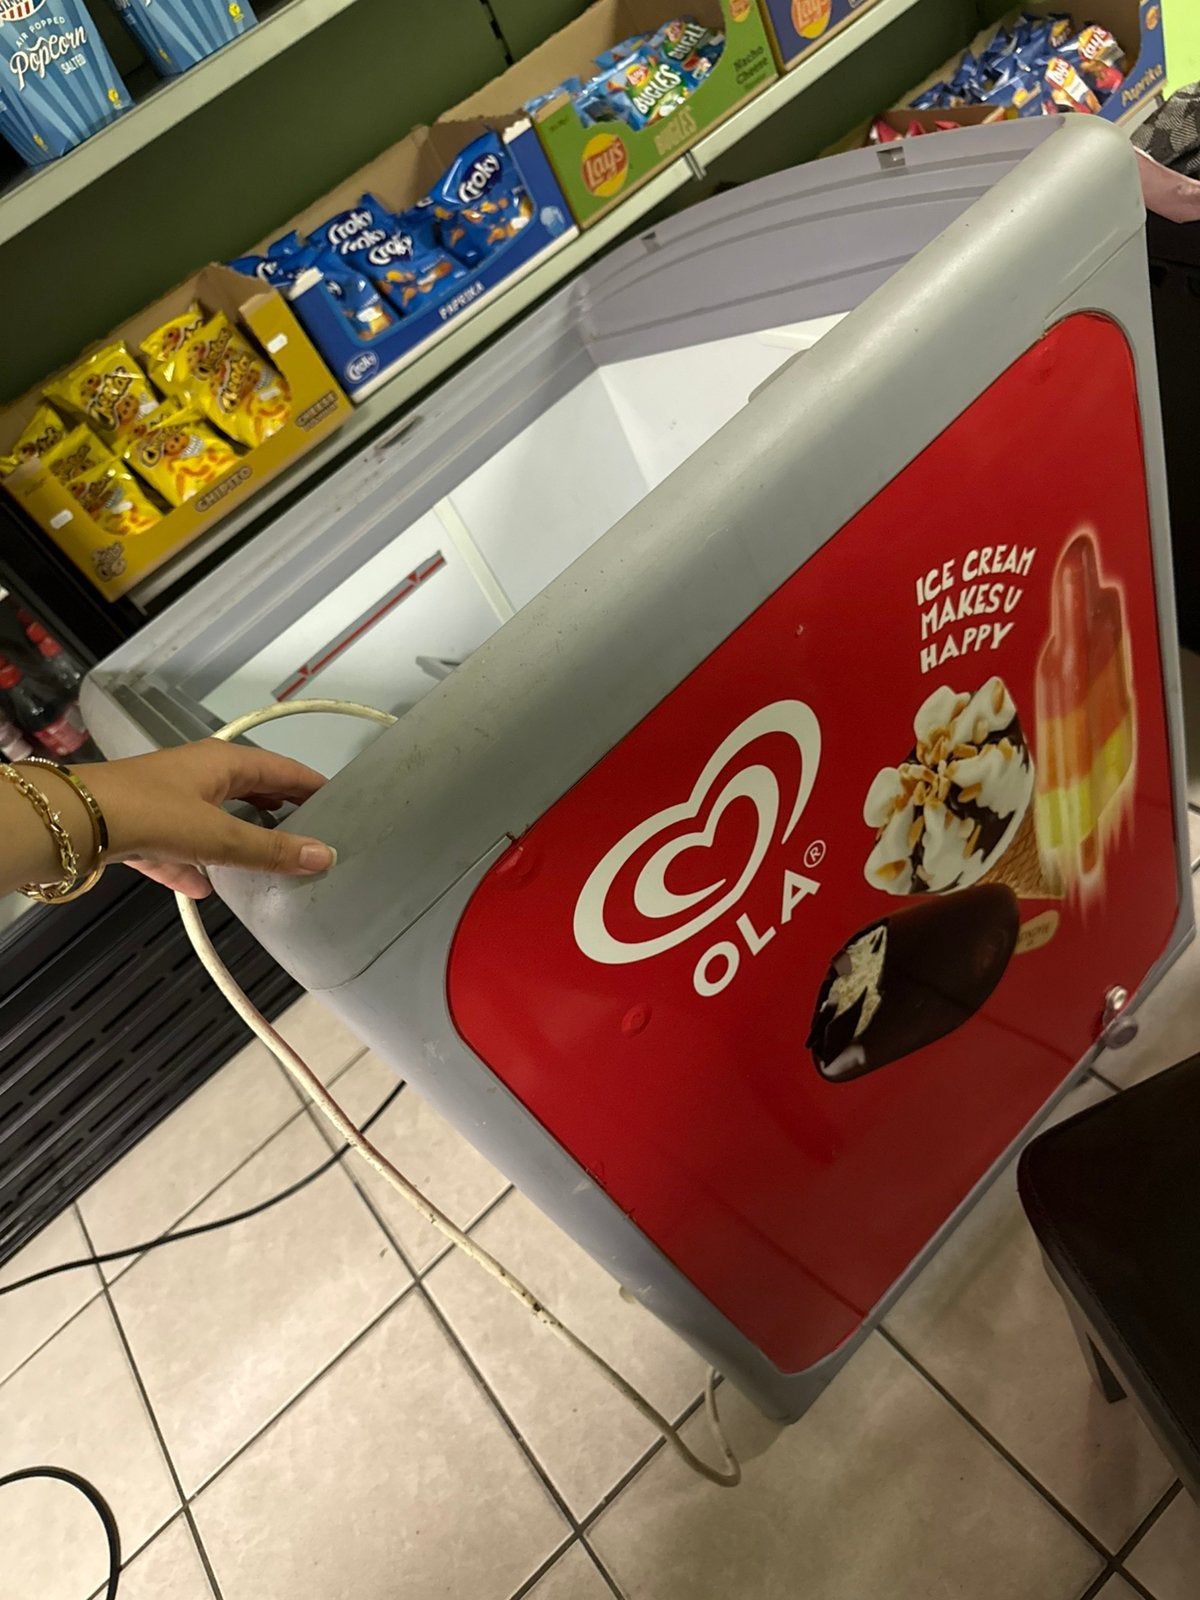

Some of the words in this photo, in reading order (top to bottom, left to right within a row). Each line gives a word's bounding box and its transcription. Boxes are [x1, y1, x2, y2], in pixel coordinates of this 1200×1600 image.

[28, 16, 66, 34] POPPED
[61, 53, 87, 75] SALTED
[1121, 64, 1163, 107] Paprika
[633, 64, 682, 115] BUGLES
[458, 154, 500, 203] Croky
[328, 211, 373, 245] Croky
[369, 234, 413, 265] Croky
[439, 281, 485, 320] PAPRIKA
[195, 466, 253, 512] CHIPITO
[916, 559, 955, 606] ICE
[962, 544, 1037, 582] CREAM
[921, 583, 1004, 641] MAKES
[1003, 586, 1023, 614] U
[920, 622, 1015, 674] HAPPY
[693, 869, 821, 997] OLA
